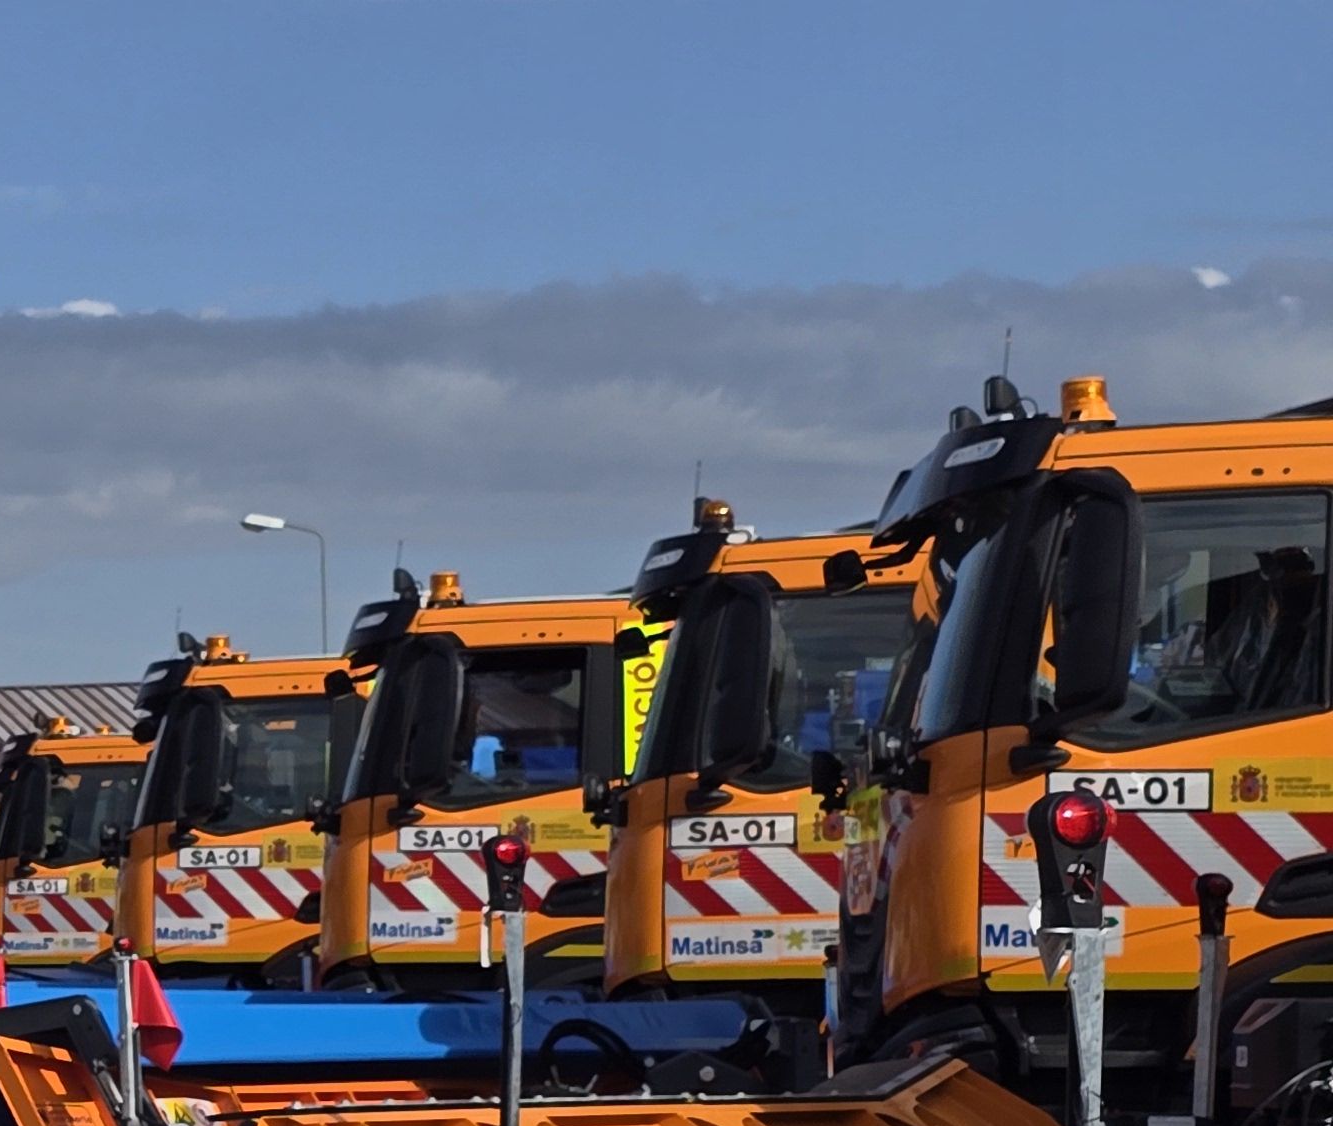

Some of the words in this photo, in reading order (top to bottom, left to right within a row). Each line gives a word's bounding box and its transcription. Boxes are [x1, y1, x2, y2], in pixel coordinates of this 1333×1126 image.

[413, 829, 483, 848] SA-01
[688, 819, 777, 842] SA-01
[190, 849, 249, 866] SA-01
[156, 926, 217, 941] Matinsa
[371, 921, 445, 938] Matinsa
[672, 937, 763, 956] Matinsa
